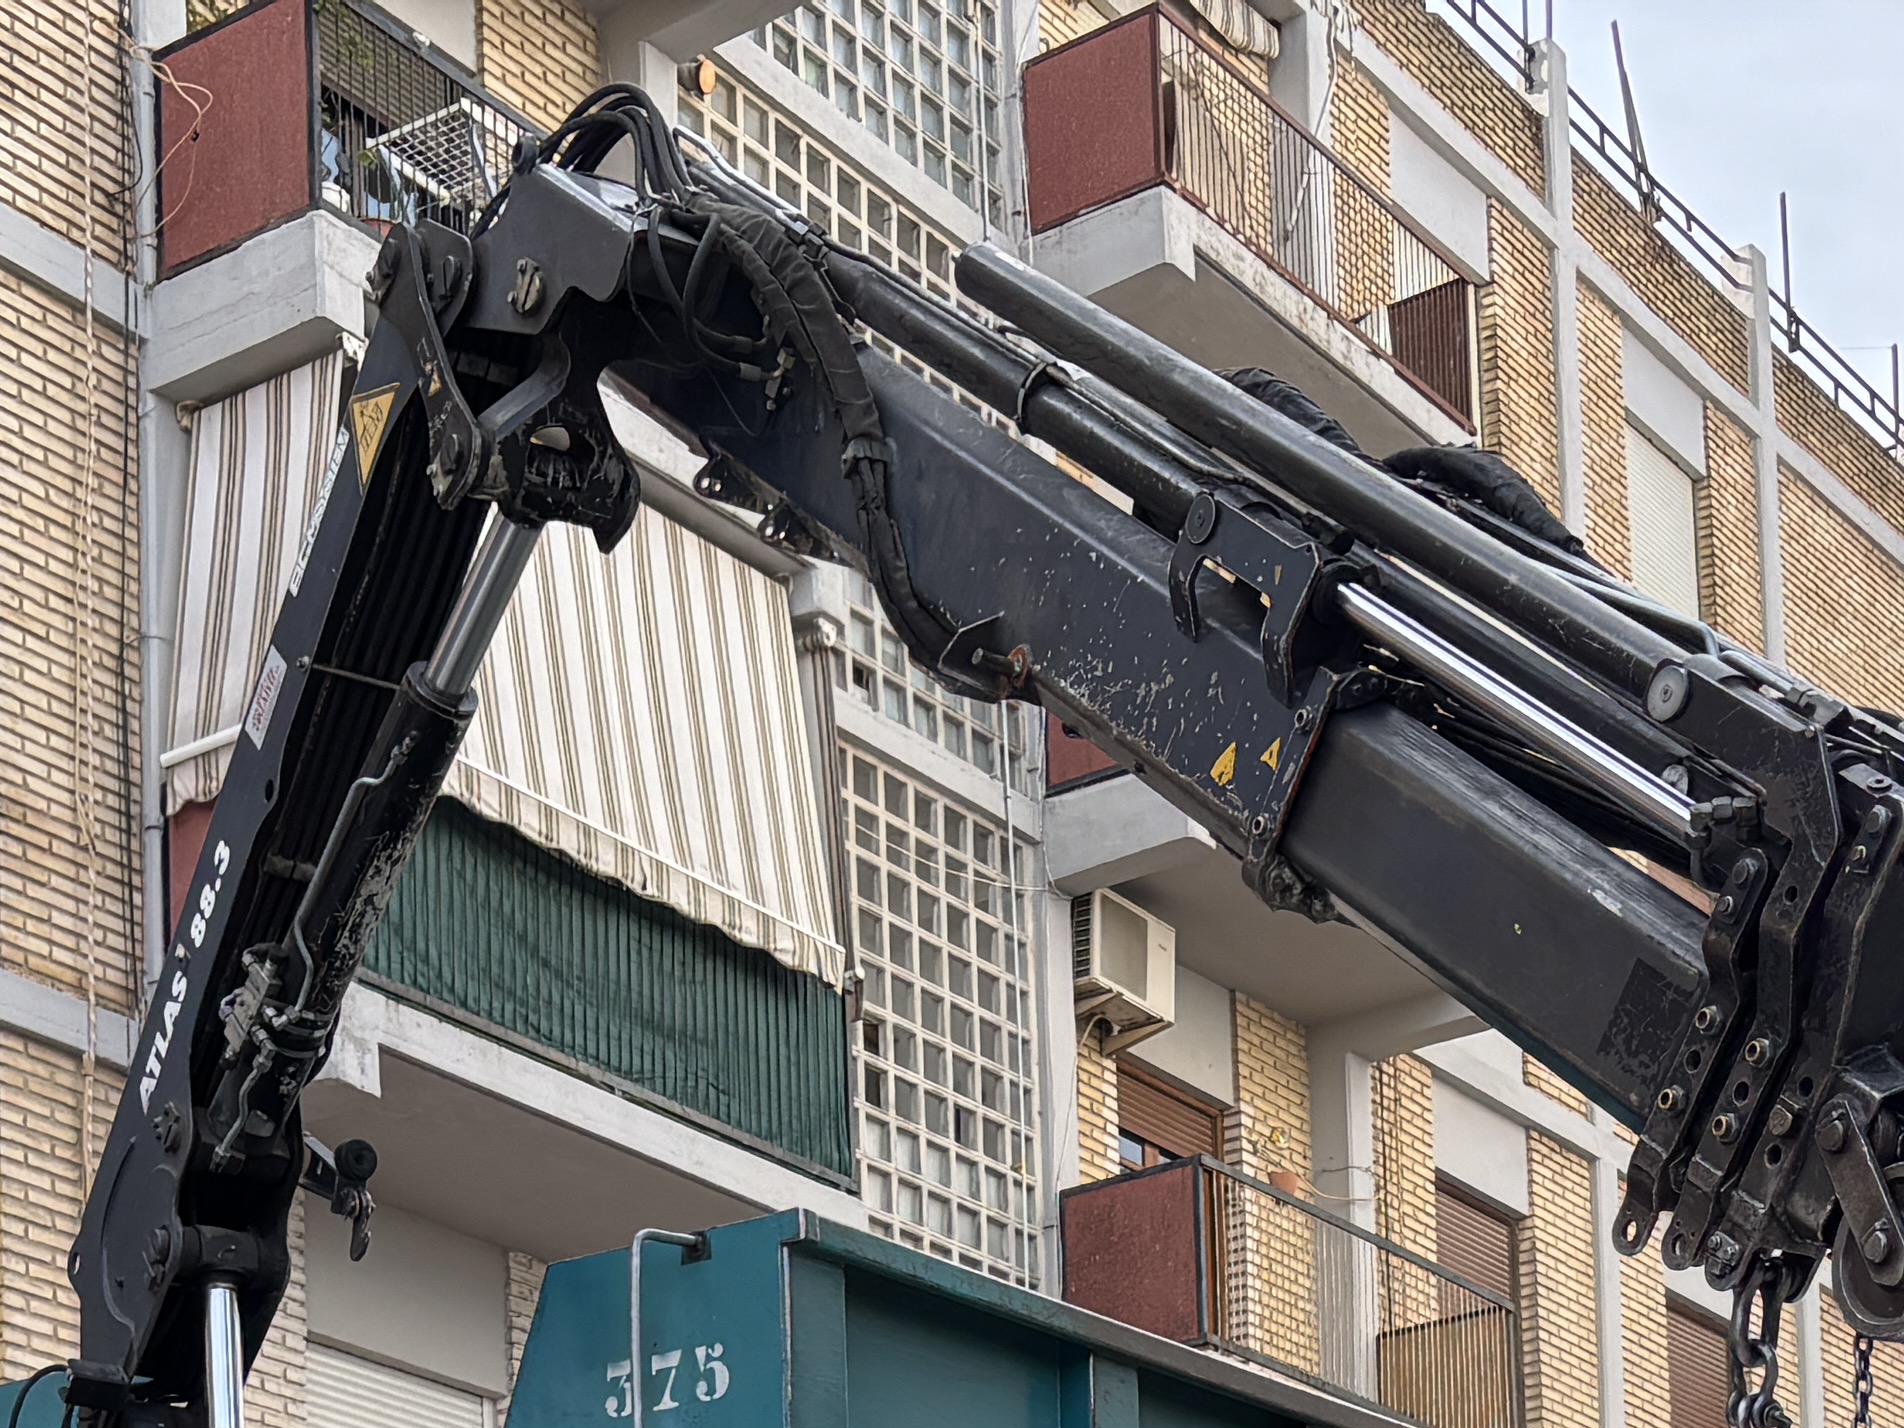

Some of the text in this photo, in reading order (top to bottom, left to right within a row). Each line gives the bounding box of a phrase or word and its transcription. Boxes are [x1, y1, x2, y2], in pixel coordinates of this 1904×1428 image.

[139, 839, 231, 1117] ATLAS 88.3
[604, 1342, 730, 1418] 375
